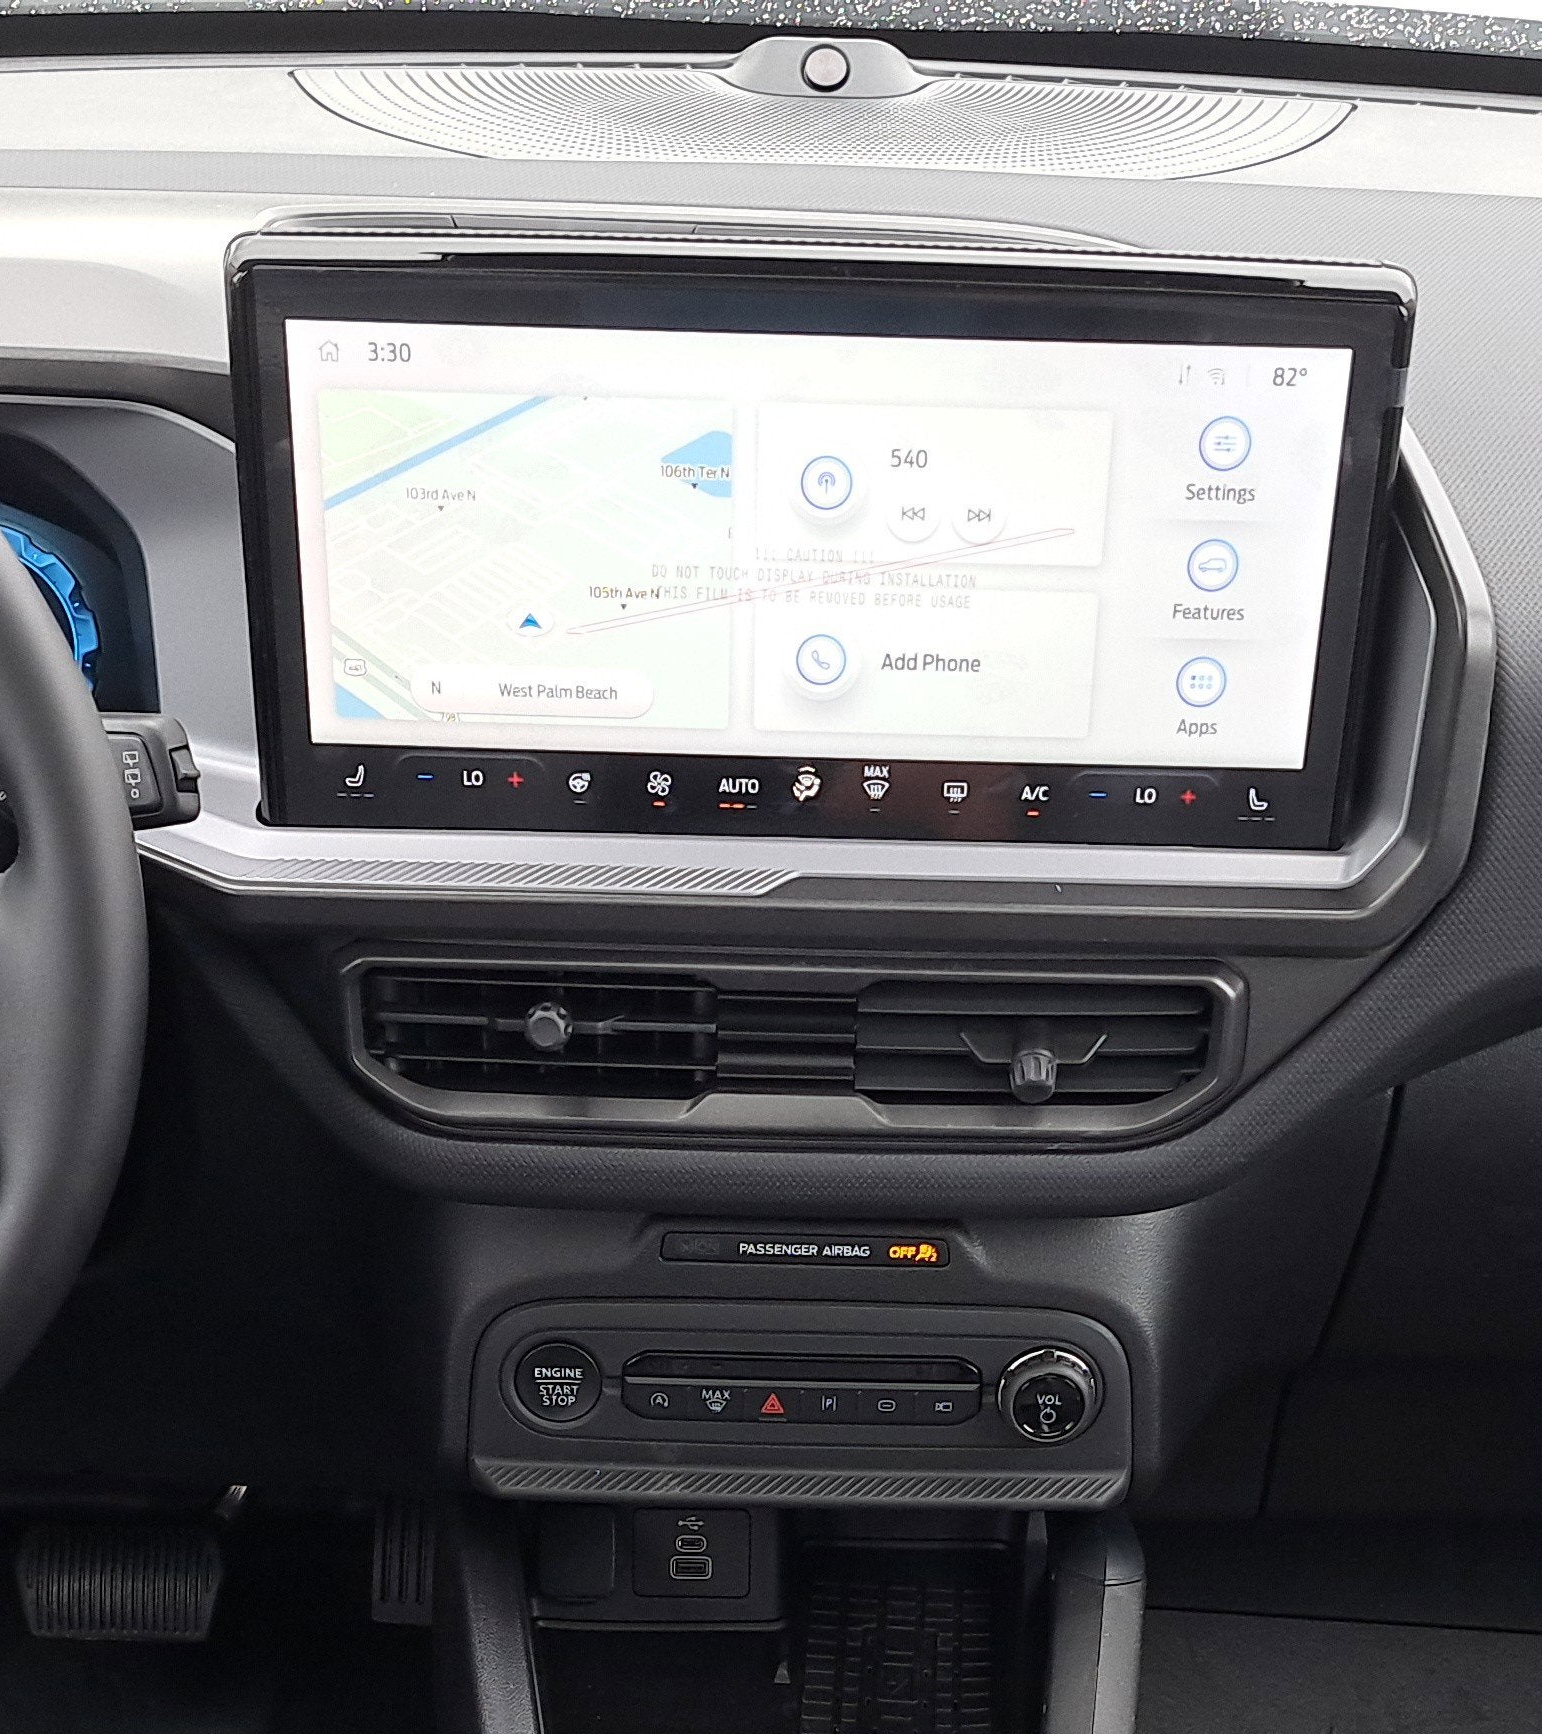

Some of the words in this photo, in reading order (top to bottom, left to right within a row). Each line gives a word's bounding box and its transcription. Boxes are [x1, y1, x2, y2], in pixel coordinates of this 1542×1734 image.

[367, 342, 412, 363] 3:30
[1271, 366, 1308, 388] 82°
[890, 449, 928, 469] 540
[660, 465, 695, 478] 106th
[698, 466, 717, 478] Ter
[720, 467, 730, 478] N
[406, 487, 439, 500] 103rd
[441, 489, 464, 501] Ave
[467, 490, 476, 501] N
[1184, 482, 1257, 505] Settings
[787, 549, 843, 562] CAUTION
[652, 564, 667, 577] DO
[676, 566, 699, 579] NOT
[709, 566, 749, 580] TOUCH
[757, 568, 813, 582] DISPLAY
[880, 572, 977, 588] INSTALLATION
[589, 586, 622, 599] 105th
[625, 587, 647, 600] Ave
[650, 588, 660, 600] N
[738, 588, 752, 601] IS
[786, 590, 800, 603] BE
[809, 591, 866, 605] REMOVED
[875, 593, 922, 607] BEFORE
[931, 594, 971, 609] USAGE
[1172, 603, 1246, 623] Features
[880, 653, 918, 673] Add
[921, 654, 981, 674] Phone
[431, 681, 441, 695] N
[499, 683, 535, 699] West
[538, 684, 573, 700] Palm
[577, 685, 618, 701] Beach
[1176, 718, 1218, 739] Apps
[462, 770, 484, 787] LO
[863, 766, 890, 778] MAX
[718, 777, 760, 794] AUTO
[1020, 785, 1049, 802] A/C
[1135, 787, 1157, 804] LO
[739, 1242, 819, 1256] PASSENGER
[822, 1244, 870, 1257] AIRBAG
[889, 1246, 916, 1259] OFF
[534, 1367, 584, 1379] ENGINE
[539, 1385, 579, 1396] START
[701, 1388, 731, 1400] MAX
[543, 1395, 576, 1406] STOP
[1036, 1393, 1062, 1406] VOL
